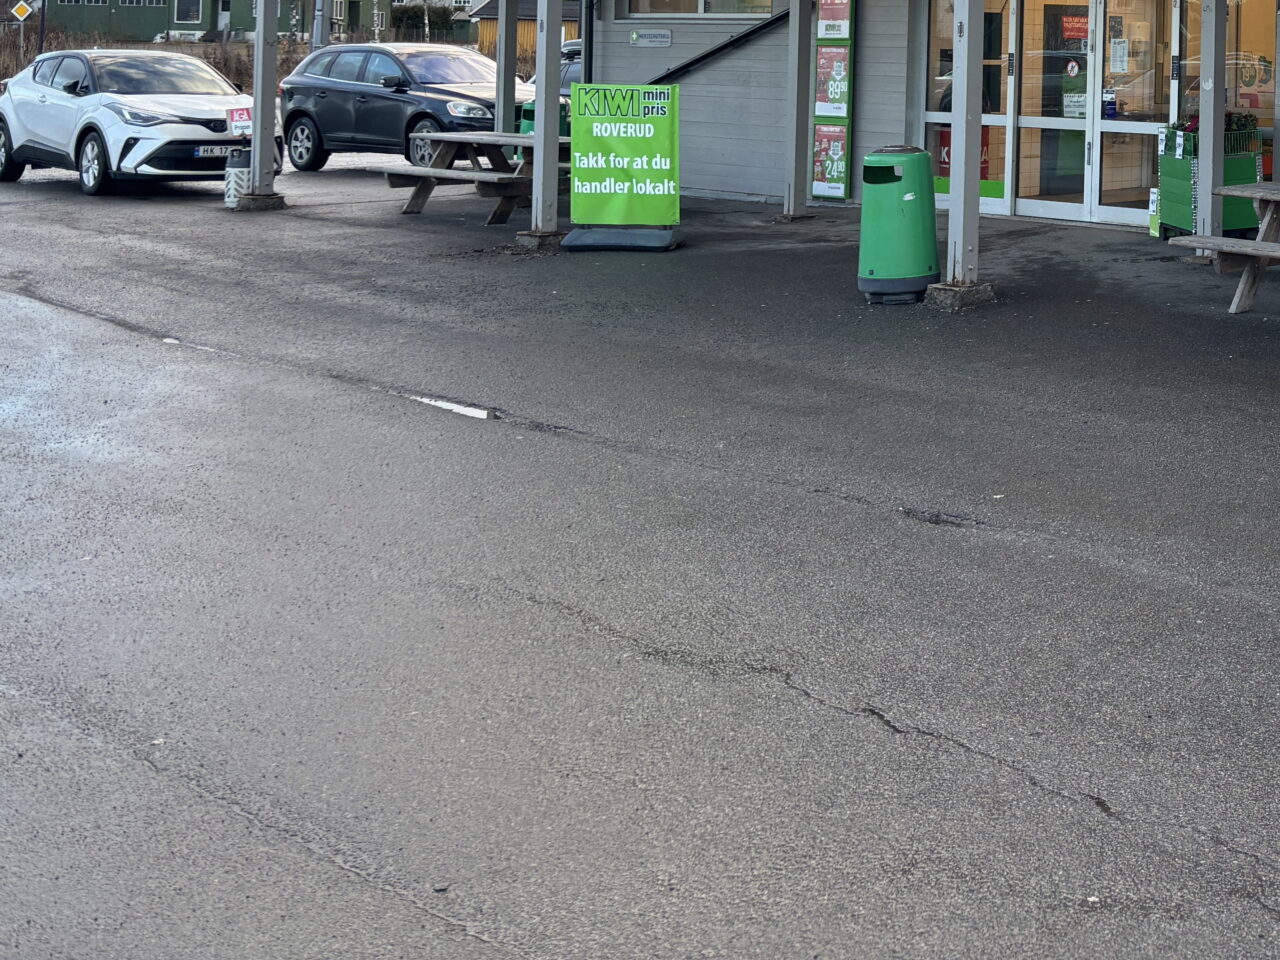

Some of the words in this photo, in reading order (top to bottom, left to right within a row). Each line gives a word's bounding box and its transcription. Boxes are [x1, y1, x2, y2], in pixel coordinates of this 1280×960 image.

[578, 88, 640, 116] KIWI
[643, 89, 670, 101] mini
[643, 103, 667, 118] pris
[593, 123, 654, 137] ROVERUD
[203, 147, 216, 155] HK
[574, 152, 606, 168] Takk
[609, 153, 630, 168] for
[632, 155, 648, 169] at
[652, 154, 671, 169] du
[574, 177, 630, 193] handler
[633, 178, 675, 194] lokalt
